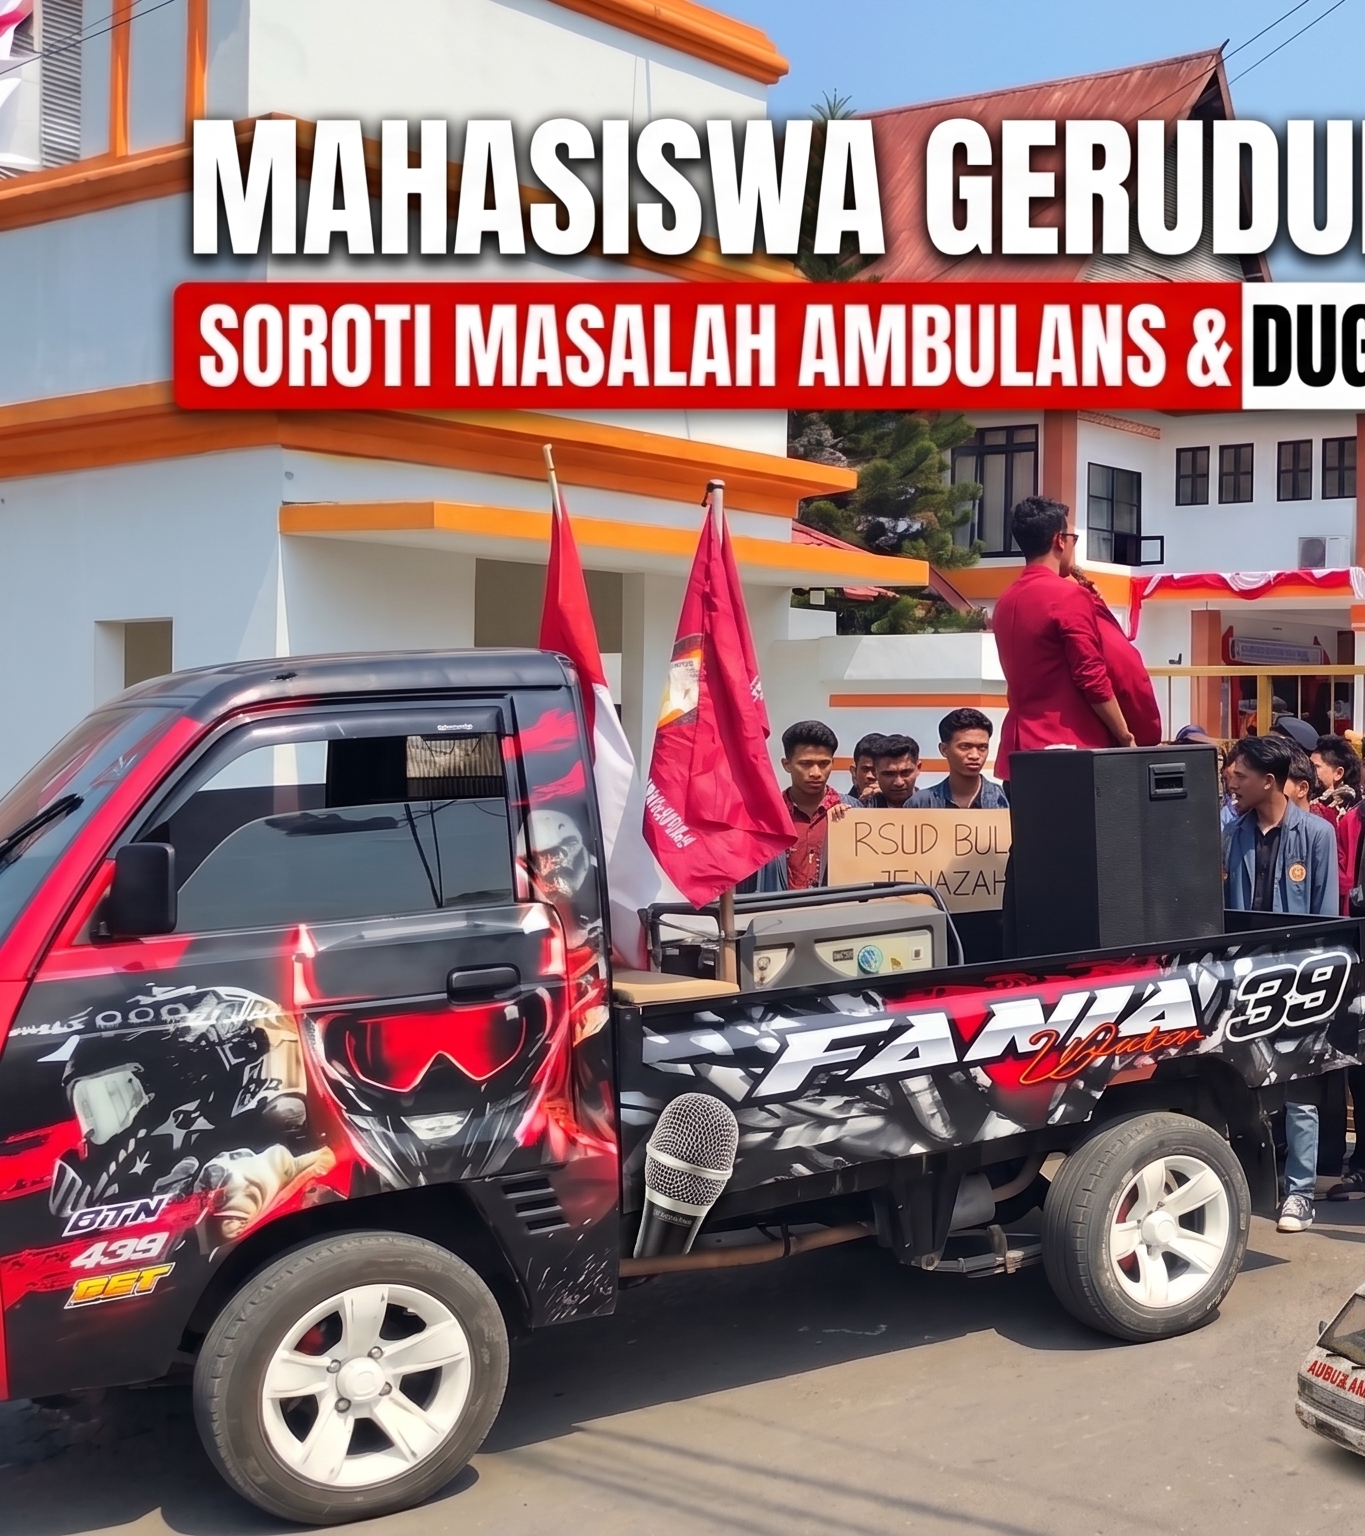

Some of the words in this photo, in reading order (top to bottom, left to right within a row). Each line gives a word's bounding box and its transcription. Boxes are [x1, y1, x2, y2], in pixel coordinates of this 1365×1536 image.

[854, 821, 939, 857] RSUD
[1225, 951, 1352, 1043] 39
[69, 1231, 170, 1270] 439
